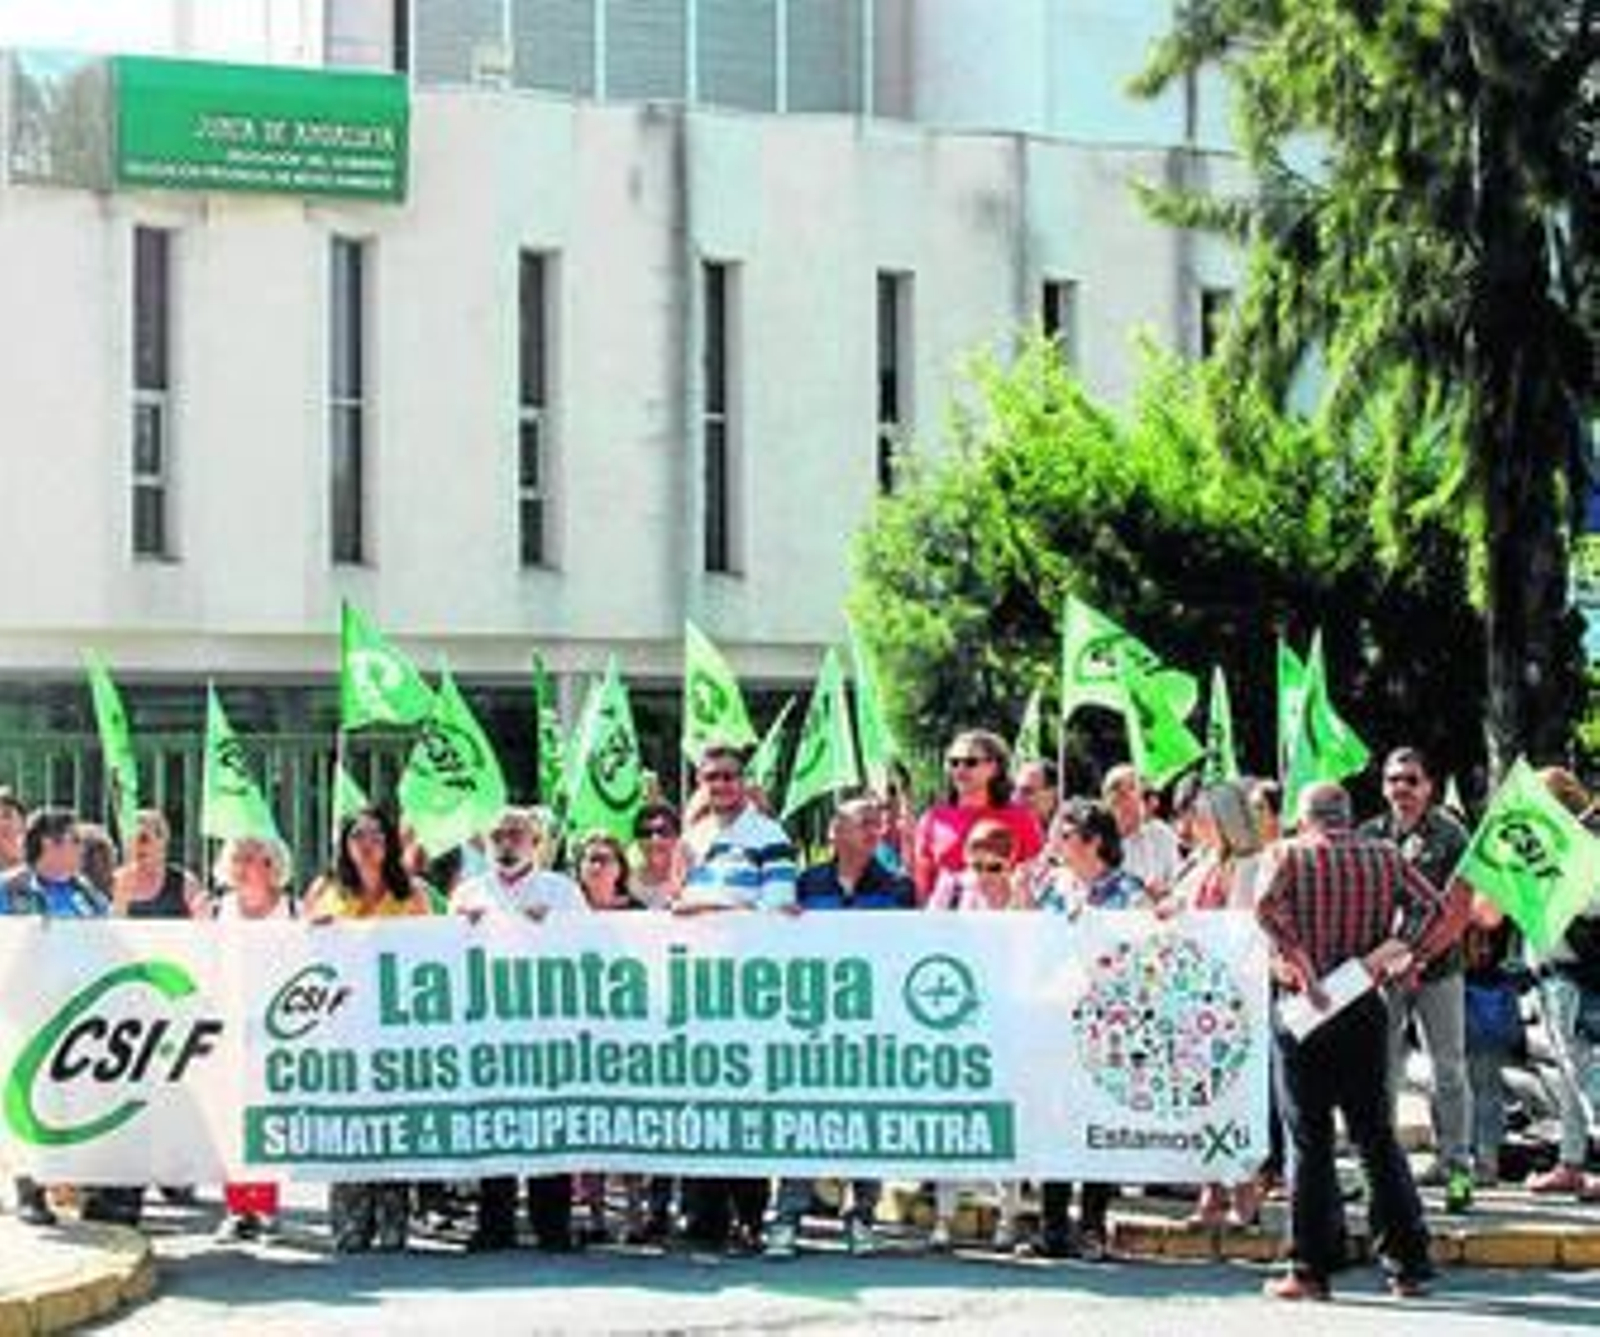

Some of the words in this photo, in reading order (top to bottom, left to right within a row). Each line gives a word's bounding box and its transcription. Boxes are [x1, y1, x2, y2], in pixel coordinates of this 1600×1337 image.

[379, 952, 451, 1026] La
[464, 945, 648, 1022] Junta
[667, 944, 873, 1030] juega
[264, 1047, 358, 1094] con
[370, 1042, 459, 1093] sus
[469, 1030, 752, 1091] empleados
[766, 1029, 993, 1093] públicos
[262, 1106, 411, 1156] SÚMATE
[450, 1102, 731, 1152] RECUPERACIÓN
[772, 1109, 869, 1152] PAGA
[877, 1110, 993, 1156] EXTRA
